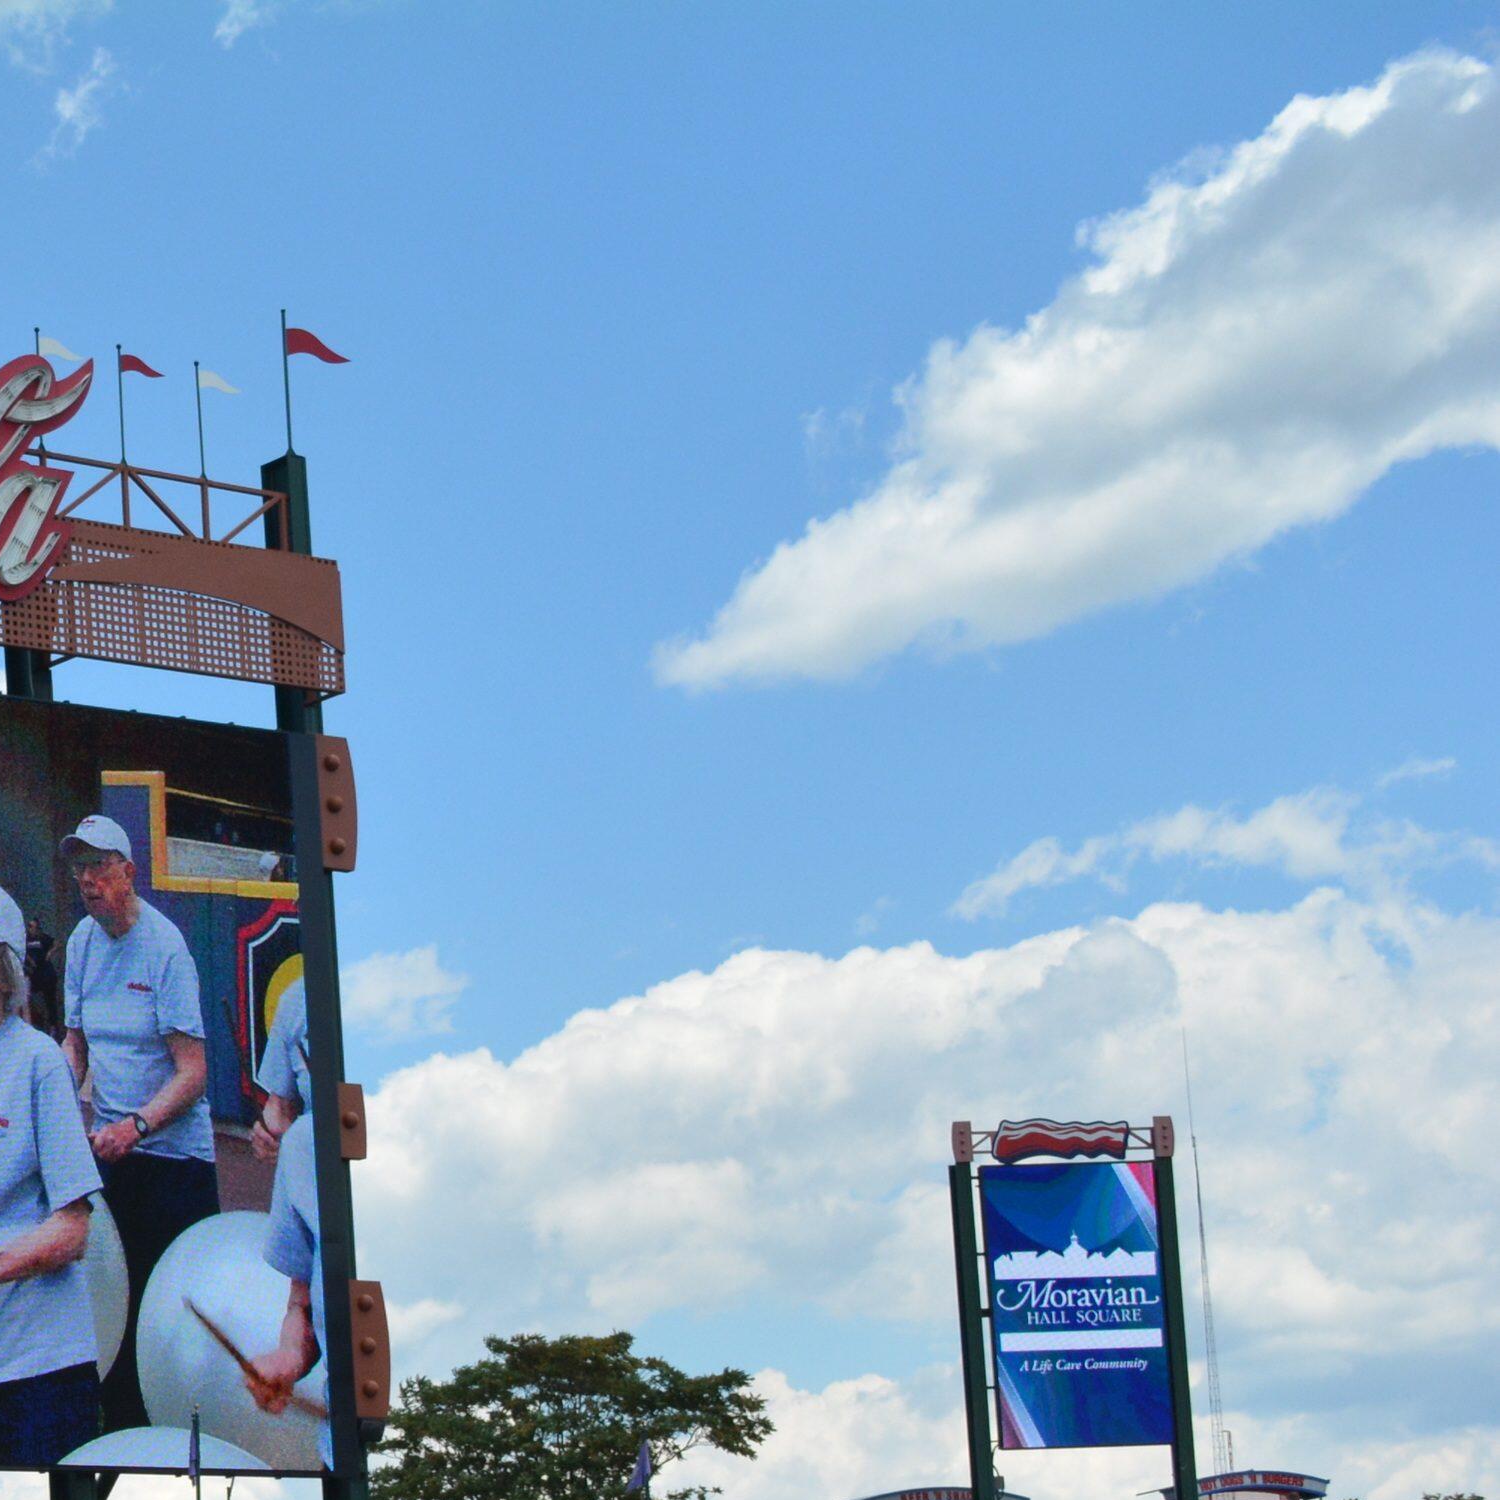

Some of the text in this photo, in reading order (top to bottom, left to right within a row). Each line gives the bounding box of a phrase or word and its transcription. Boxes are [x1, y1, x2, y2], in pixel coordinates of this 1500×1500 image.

[996, 1278, 1160, 1311] Moravian
[1027, 1308, 1143, 1327] HALL SQUARE
[1019, 1357, 1149, 1375] A Life Care Community
